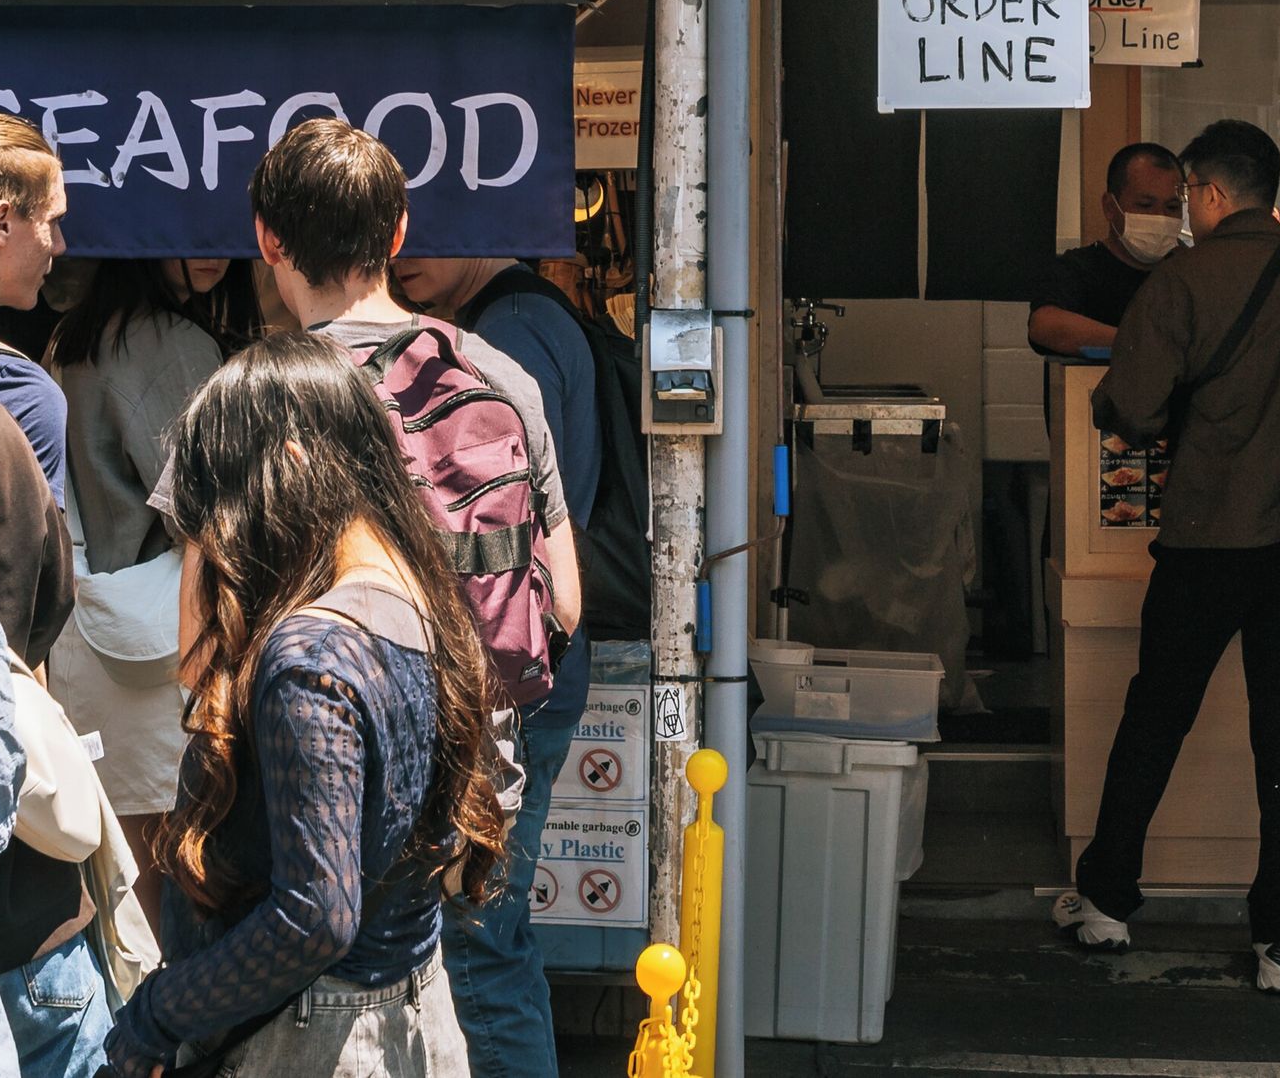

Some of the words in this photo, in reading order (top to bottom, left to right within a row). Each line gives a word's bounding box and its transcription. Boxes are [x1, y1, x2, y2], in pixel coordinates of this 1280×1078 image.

[1122, 17, 1180, 50] Line
[917, 36, 1057, 84] LINE
[576, 89, 637, 106] Never
[582, 822, 624, 835] garbage
[560, 839, 625, 859] Plastic
